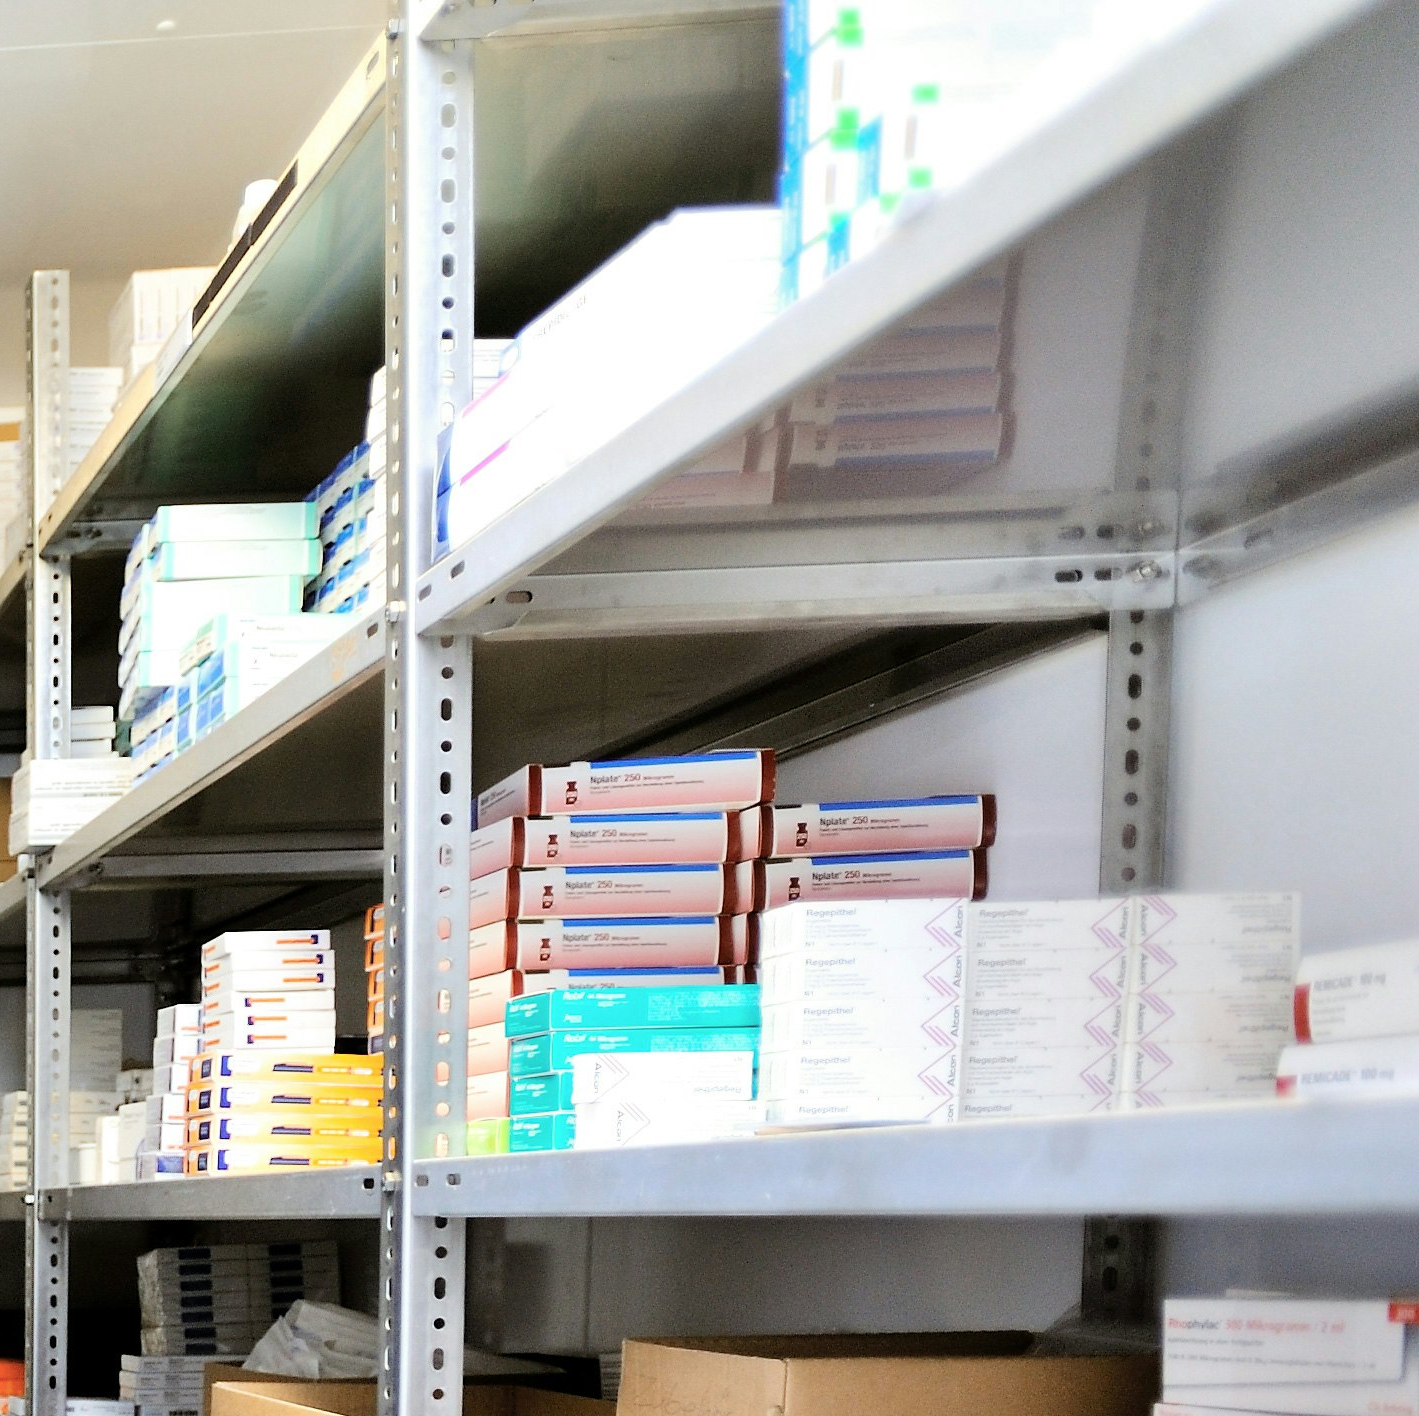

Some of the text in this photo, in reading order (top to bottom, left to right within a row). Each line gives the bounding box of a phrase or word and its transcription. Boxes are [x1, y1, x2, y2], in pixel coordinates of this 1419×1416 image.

[590, 773, 641, 785] Nplate 250
[819, 815, 869, 827] Nplate 250
[569, 829, 617, 839] Nplate 250
[812, 870, 861, 881] Nplate 250
[565, 880, 613, 890] Nplate 250
[806, 908, 857, 918] Regepithel
[979, 908, 1028, 919] Regepithel
[954, 905, 963, 938] Alcon
[1119, 906, 1129, 939] Alcon
[1140, 904, 1148, 937] Alcon
[562, 932, 610, 943] Nplate 250
[805, 957, 856, 967] Regepithel
[977, 957, 1026, 968] Regepithel
[953, 954, 962, 988] Alcon
[1116, 955, 1126, 989] Alcon
[1140, 953, 1148, 986] Alcon
[803, 1006, 854, 1017] Regepithel
[972, 1007, 1021, 1018] Regepithel
[951, 1004, 960, 1038] Alcon
[1112, 1004, 1121, 1038] Alcon
[1137, 1002, 1145, 1036] Alcon
[800, 1056, 851, 1066] Regepithel
[969, 1055, 1017, 1066] Regepithel
[947, 1054, 956, 1087] Alcon
[1107, 1053, 1117, 1086] Alcon
[1134, 1052, 1143, 1085] Alcon
[1301, 1069, 1395, 1084] REMICADE mg
[798, 1105, 849, 1115] Regepithel
[964, 1104, 1013, 1114] Regepithel
[616, 1110, 624, 1142] Alcon
[1168, 1318, 1220, 1332] Rhophylac
